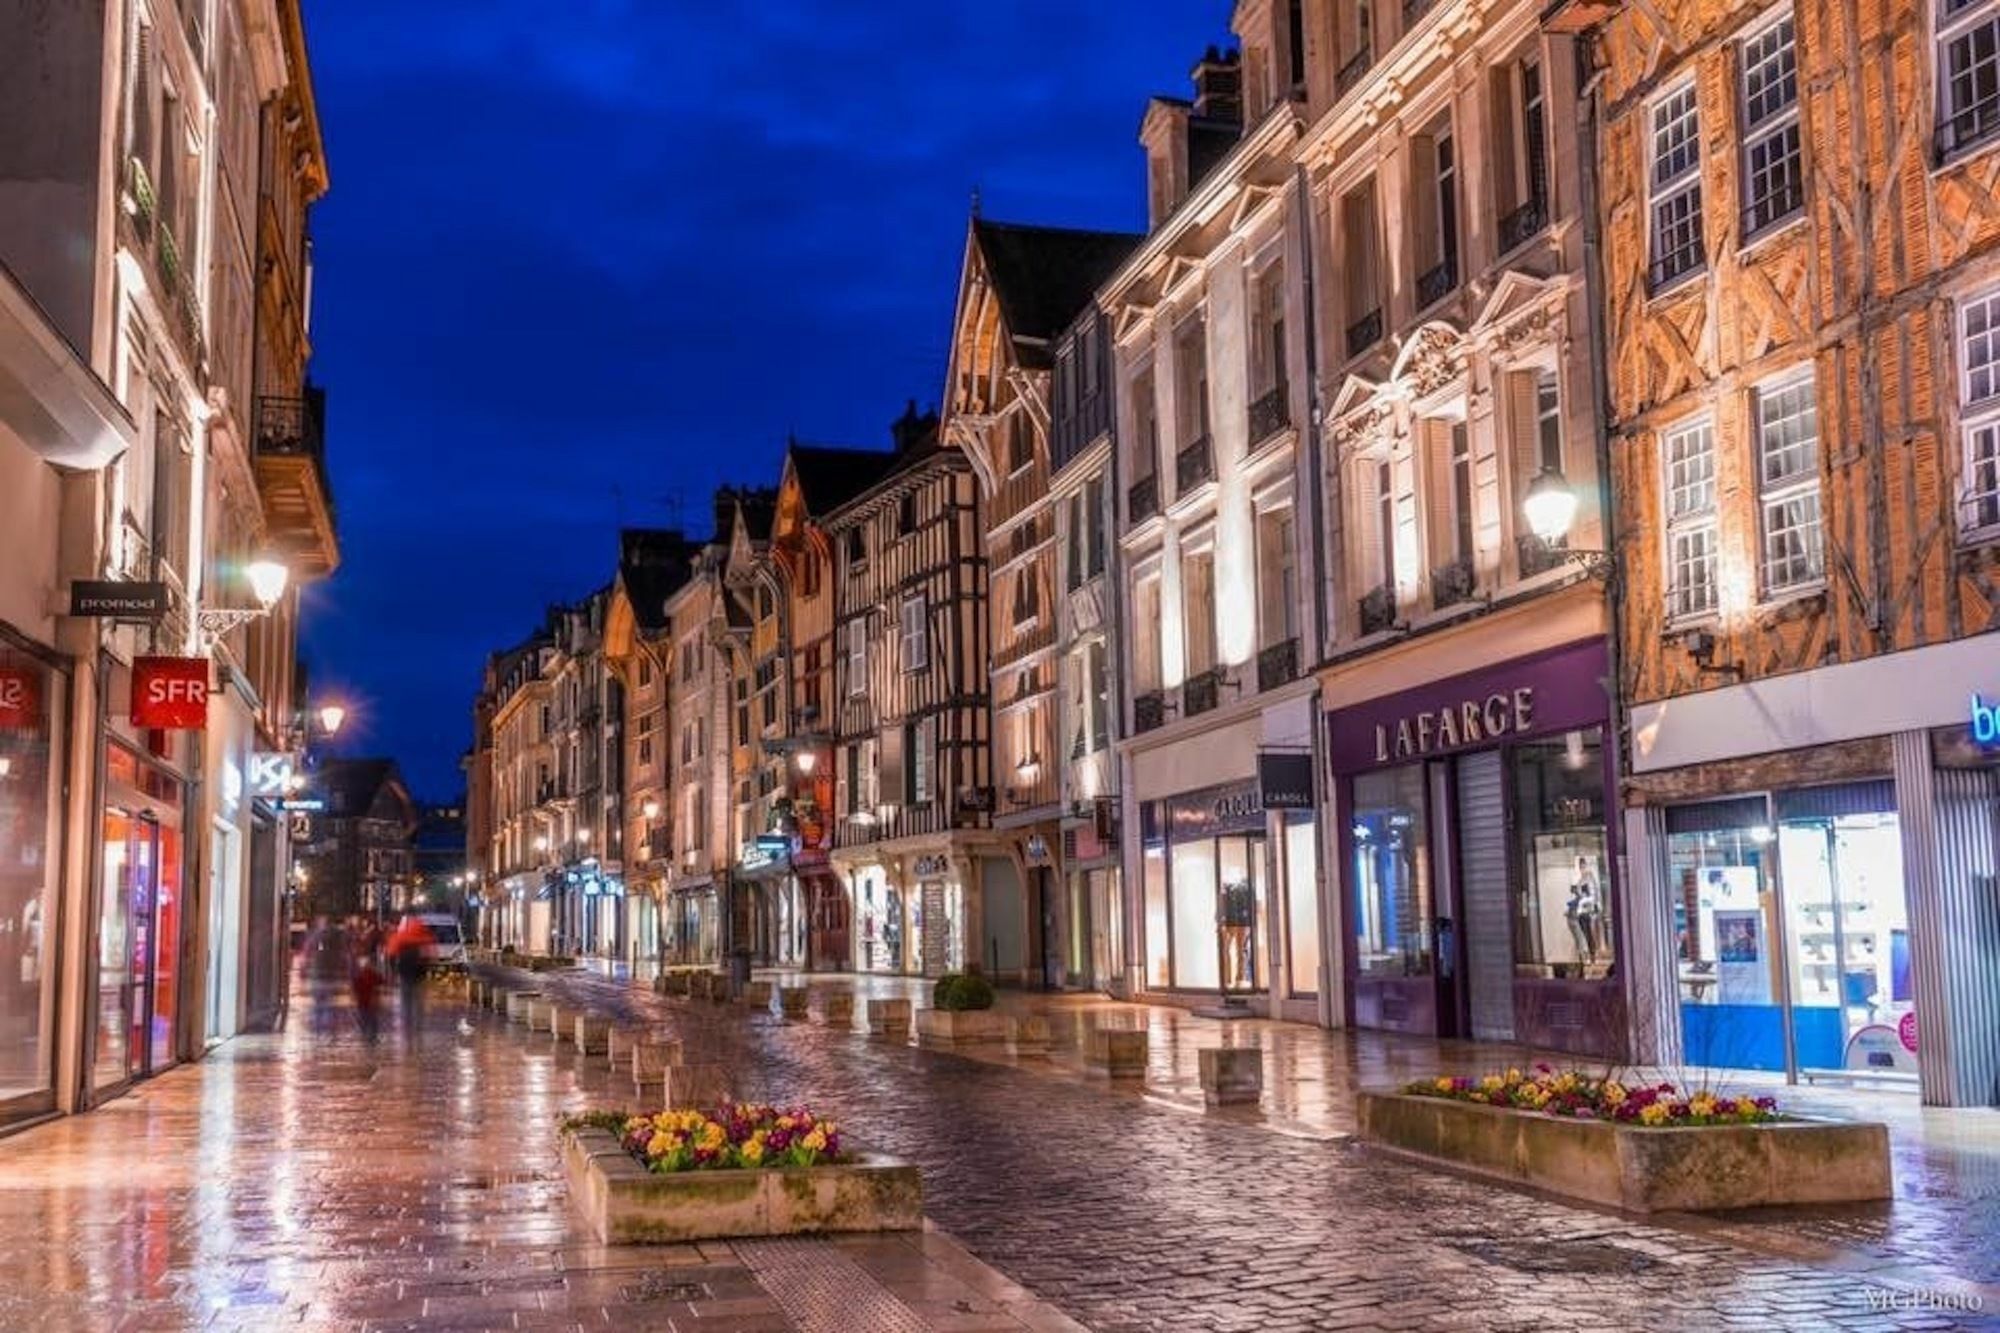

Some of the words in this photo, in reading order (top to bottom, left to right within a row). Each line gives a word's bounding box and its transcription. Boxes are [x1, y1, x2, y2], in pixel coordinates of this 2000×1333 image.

[80, 598, 156, 611] promod
[148, 677, 206, 703] SFR
[1375, 687, 1533, 762] LAFARGE
[1972, 691, 2000, 741] b
[1265, 793, 1309, 803] CAROLL
